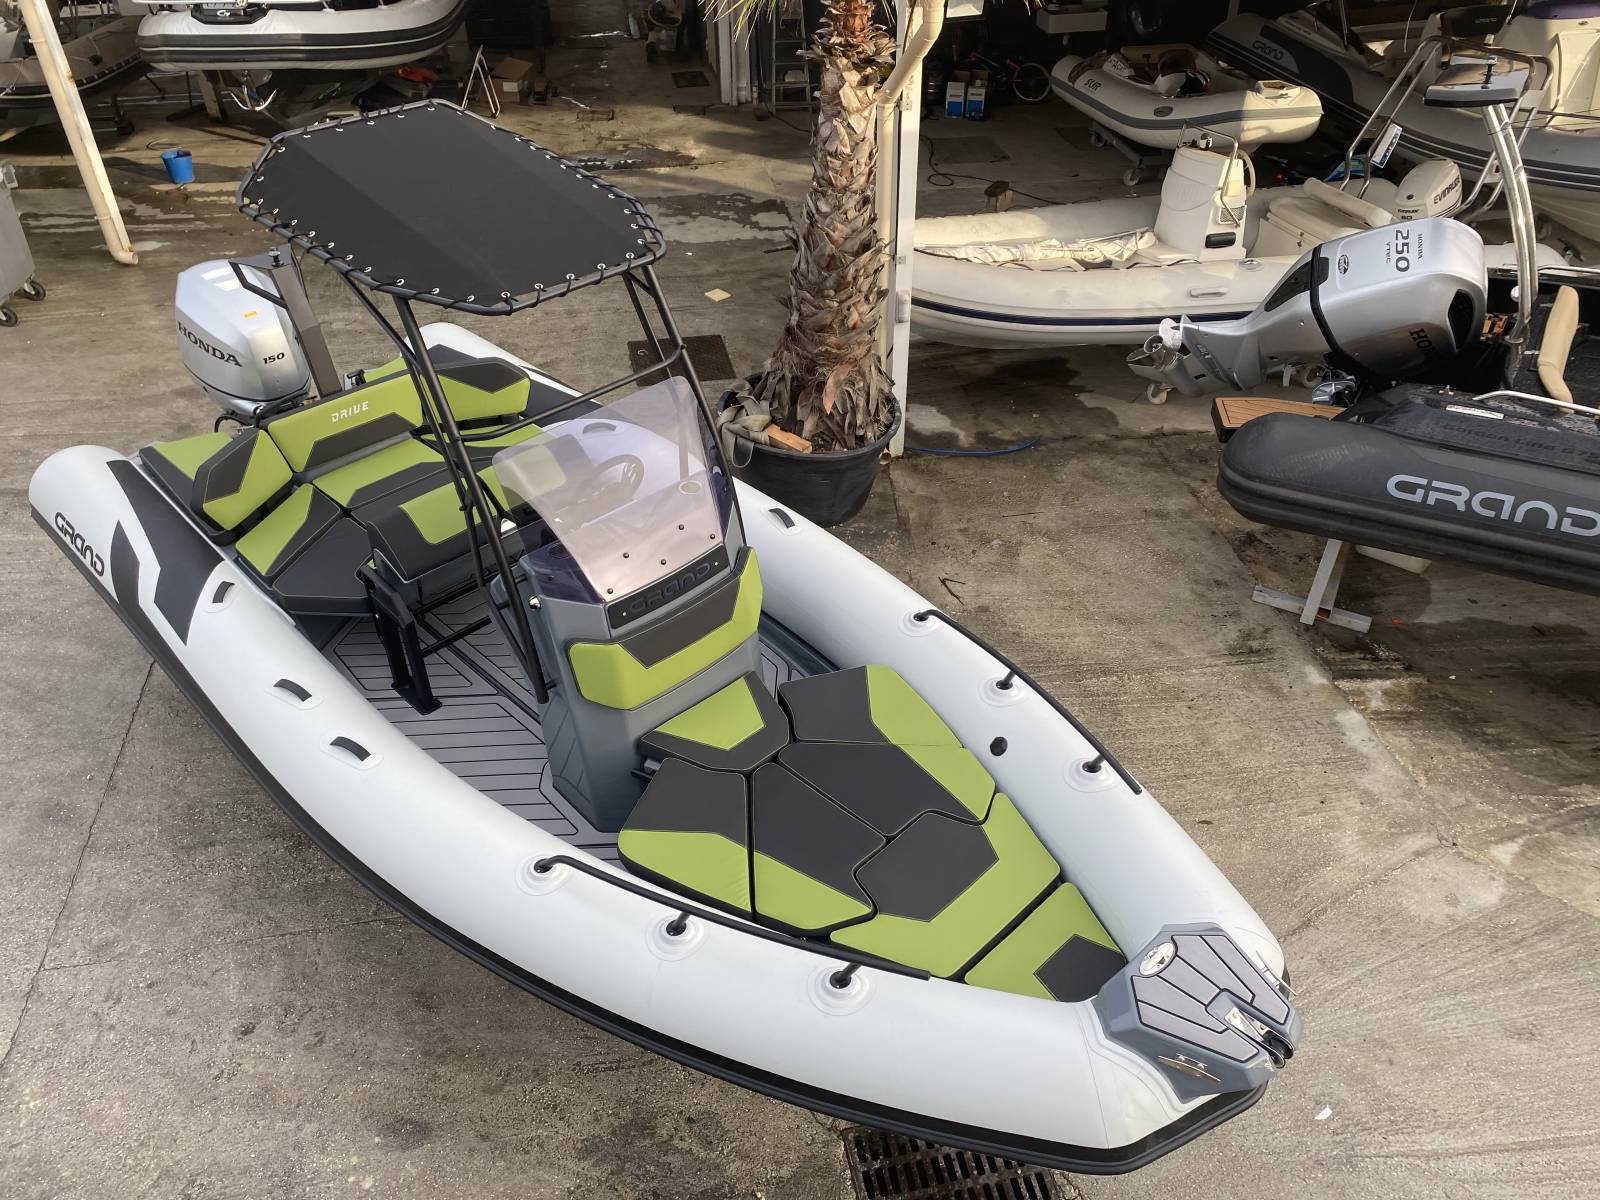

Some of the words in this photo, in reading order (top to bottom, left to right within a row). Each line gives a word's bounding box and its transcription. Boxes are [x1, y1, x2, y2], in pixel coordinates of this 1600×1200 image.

[1395, 228, 1410, 273] 250
[1417, 232, 1425, 260] HONDA
[178, 321, 243, 367] HONDA
[263, 352, 285, 365] 150
[331, 400, 369, 423] DRIVE
[1386, 474, 1600, 537] GRAND
[54, 511, 105, 577] GRAND
[630, 562, 711, 613] GRAND
